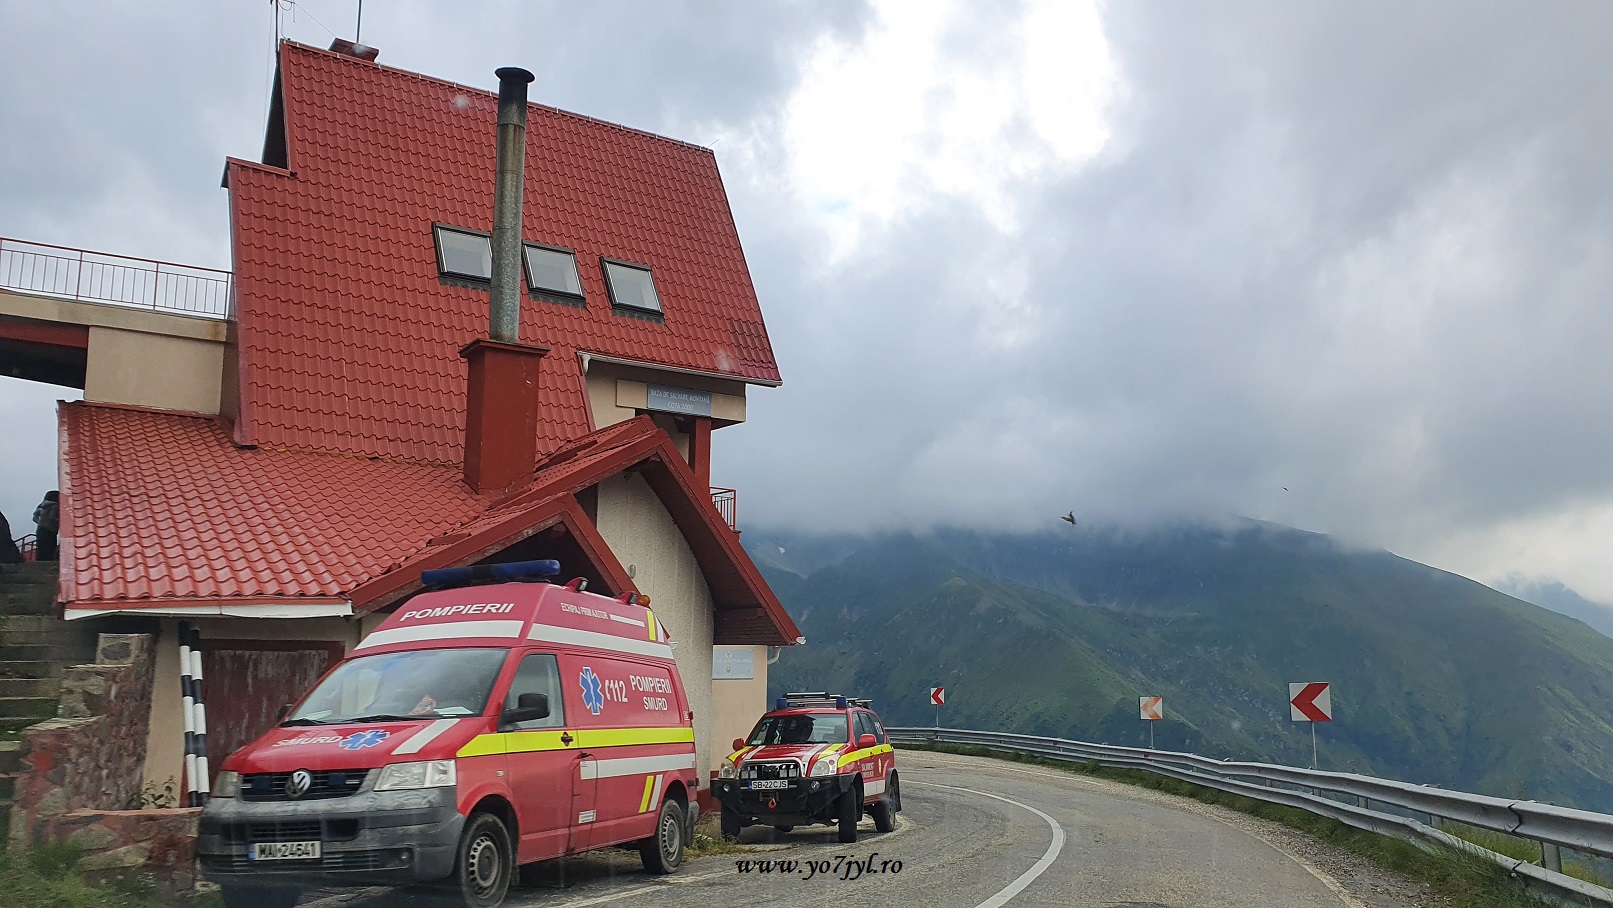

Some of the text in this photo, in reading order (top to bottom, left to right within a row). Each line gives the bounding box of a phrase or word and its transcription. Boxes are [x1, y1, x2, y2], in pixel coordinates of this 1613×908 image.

[650, 389, 662, 397] BAZA
[667, 401, 694, 411] COTA 2000
[399, 603, 515, 622] POMPIERII
[609, 679, 629, 703] 112
[629, 674, 672, 694] POMPIERII
[642, 696, 668, 711] SMURD
[273, 735, 343, 748] SMURD
